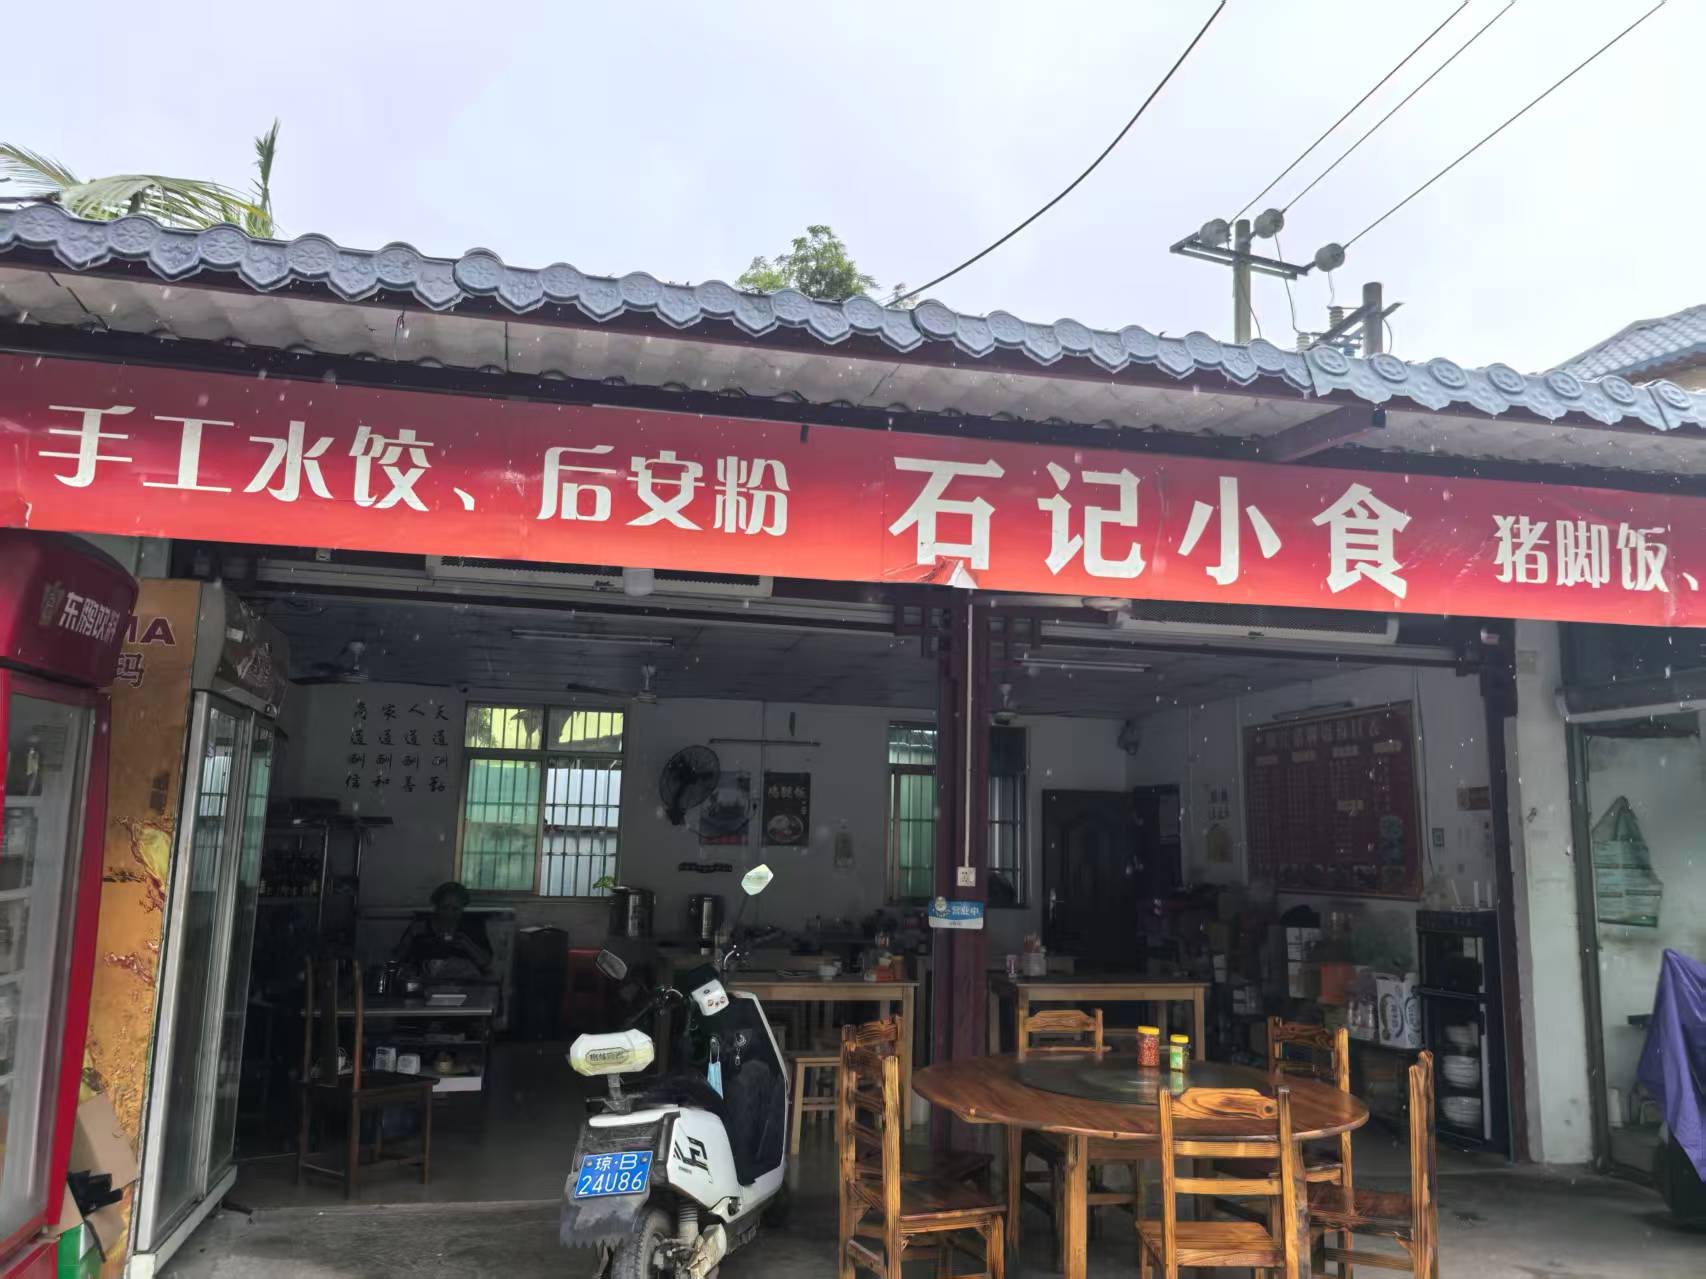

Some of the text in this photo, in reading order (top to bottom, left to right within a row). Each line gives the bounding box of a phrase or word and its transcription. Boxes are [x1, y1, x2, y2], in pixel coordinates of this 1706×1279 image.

[888, 456, 1412, 598] 石记小食
[579, 1171, 643, 1194] 24U86
